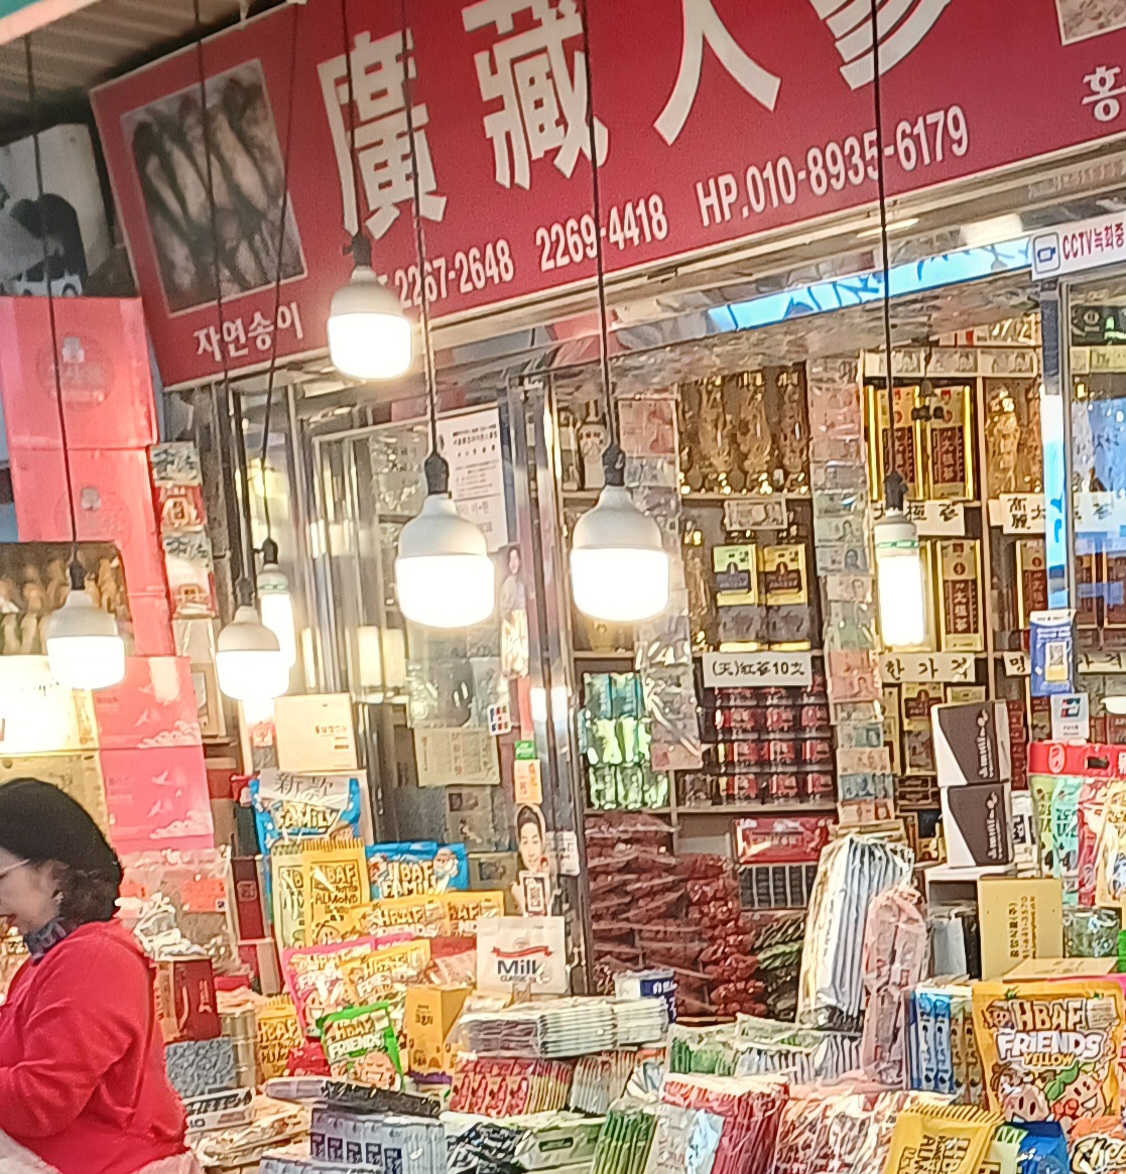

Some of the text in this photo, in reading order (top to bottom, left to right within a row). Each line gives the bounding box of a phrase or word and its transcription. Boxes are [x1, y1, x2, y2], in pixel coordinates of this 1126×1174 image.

[317, 0, 956, 238] 廣藏人
[536, 194, 669, 271] 2269-4418
[193, 302, 303, 363] 자연송이
[1011, 998, 1084, 1031] HBAF
[995, 1029, 1103, 1061] FRIENDS
[1021, 1052, 1075, 1071] YELLOW
